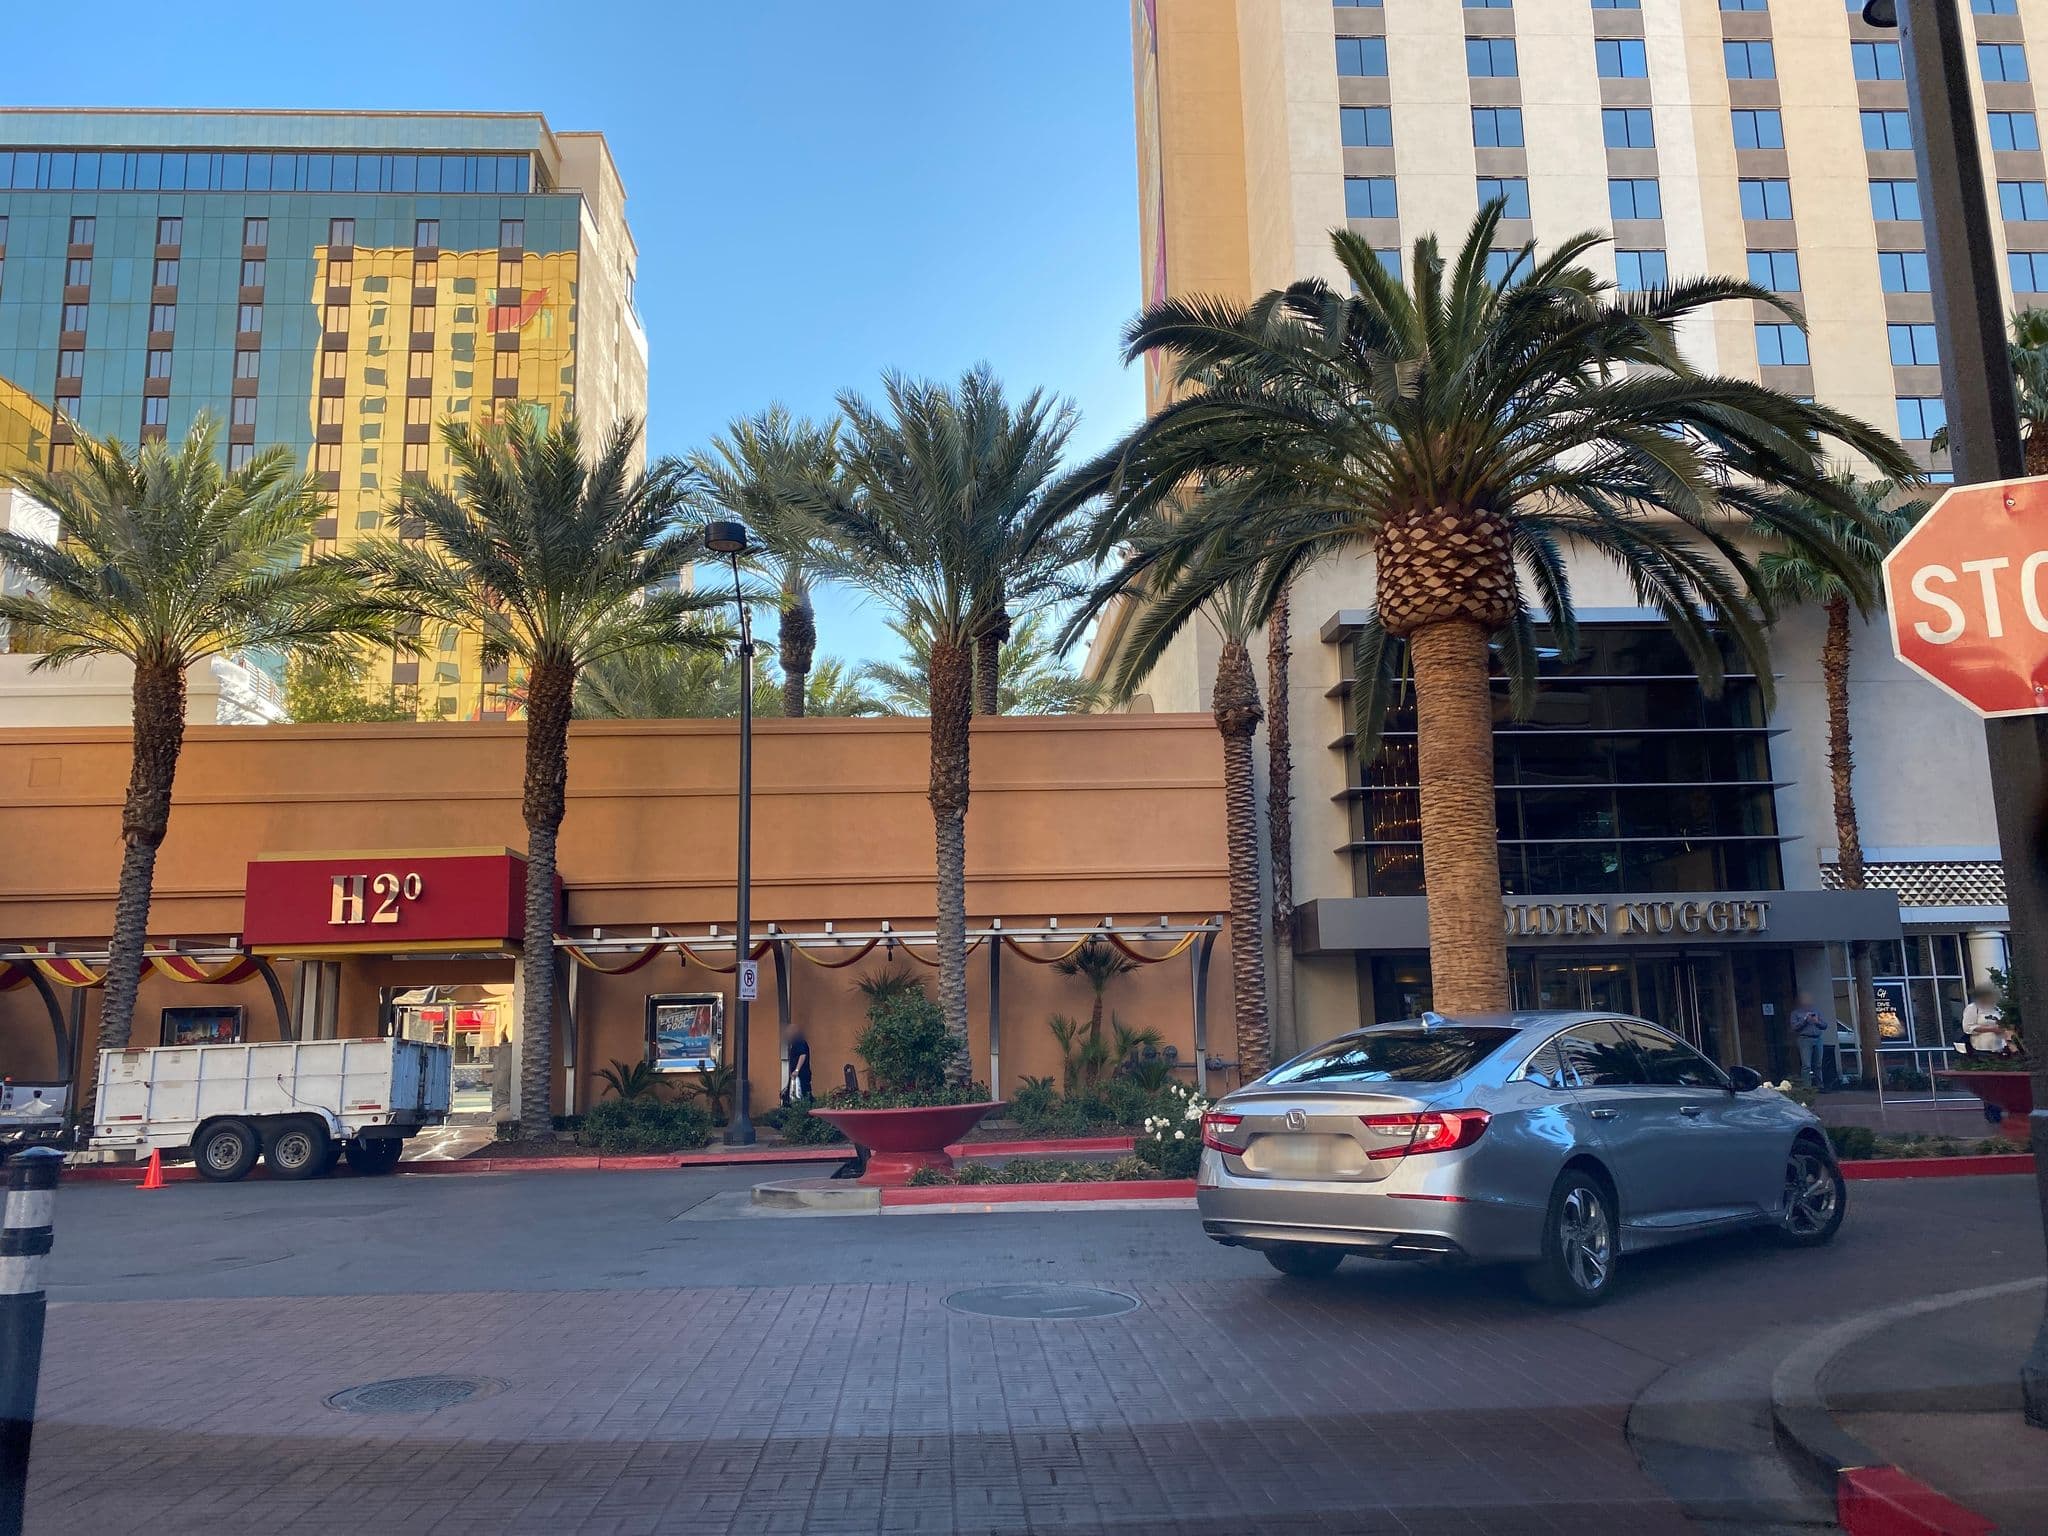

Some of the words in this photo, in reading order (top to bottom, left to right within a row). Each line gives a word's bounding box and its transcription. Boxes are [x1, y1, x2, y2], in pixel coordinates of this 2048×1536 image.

[1911, 550, 2048, 645] STO
[1504, 903, 1608, 936] OLDEN
[1622, 900, 1772, 935] NUGGET
[666, 1020, 689, 1033] POOL
